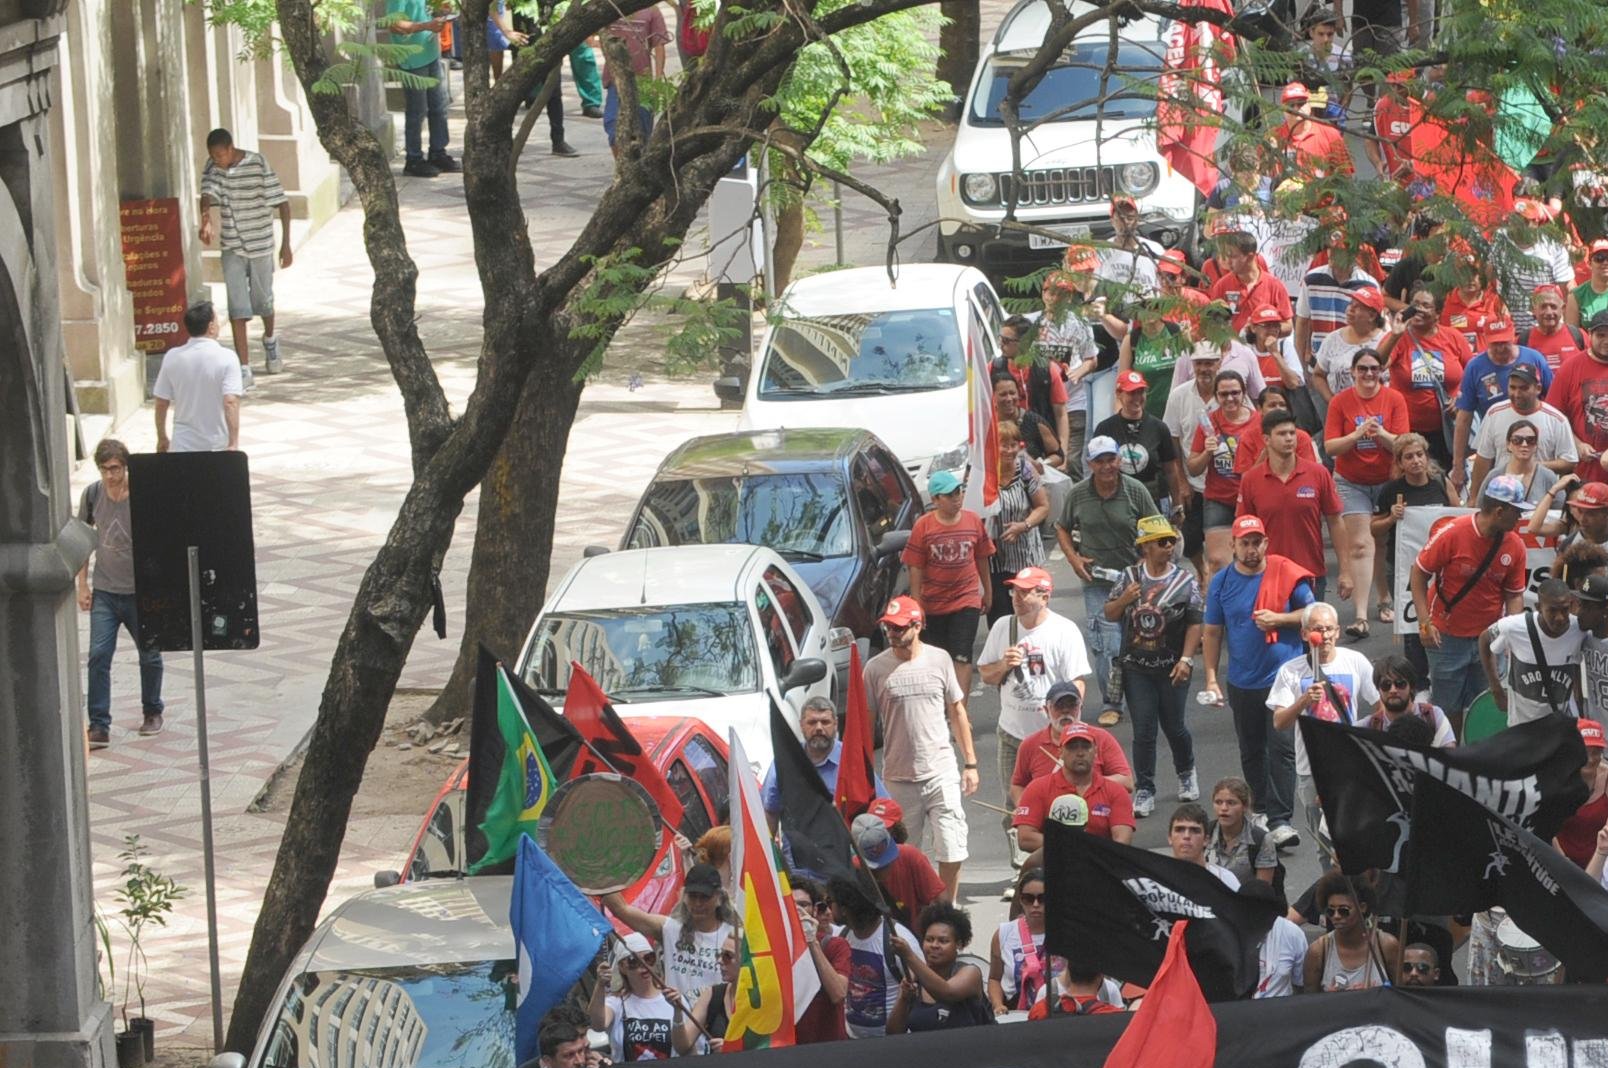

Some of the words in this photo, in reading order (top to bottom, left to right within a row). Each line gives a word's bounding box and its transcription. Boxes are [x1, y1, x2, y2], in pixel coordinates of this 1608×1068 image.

[145, 304, 183, 315] Segredo
[1521, 669, 1572, 689] BROKLYN
[653, 1022, 669, 1032] AO
